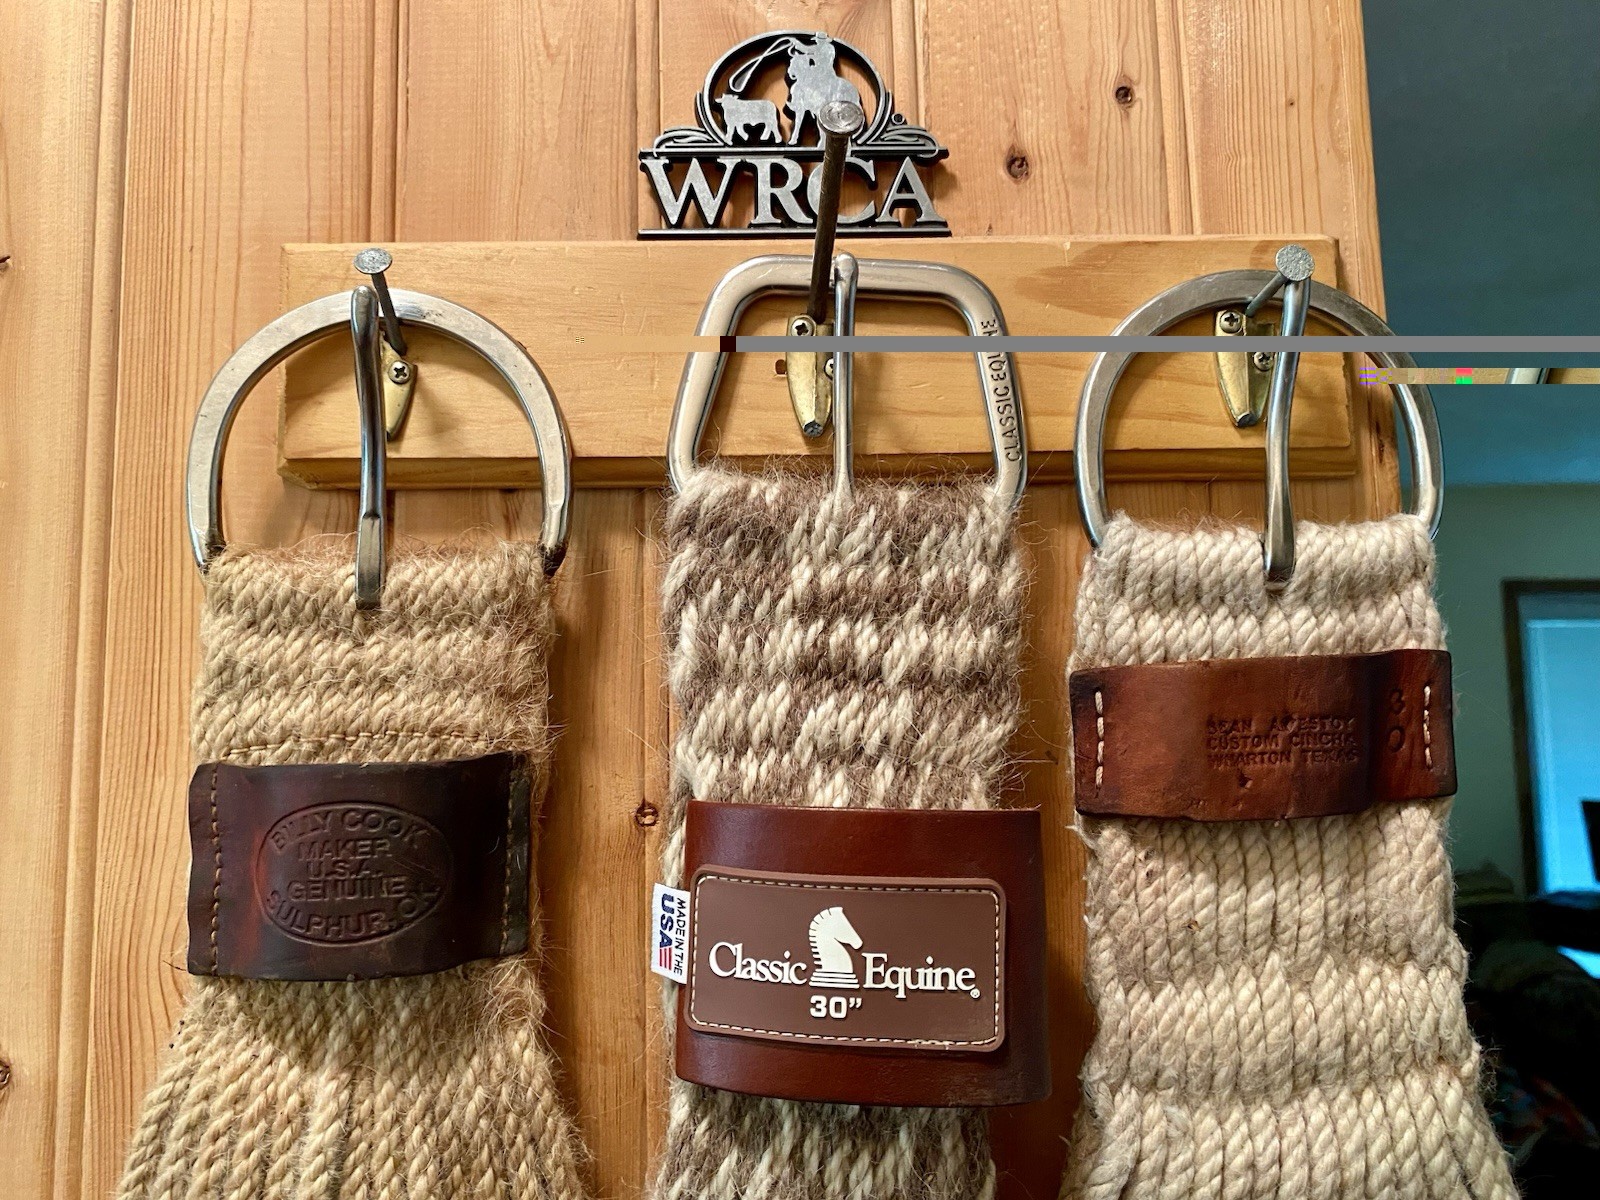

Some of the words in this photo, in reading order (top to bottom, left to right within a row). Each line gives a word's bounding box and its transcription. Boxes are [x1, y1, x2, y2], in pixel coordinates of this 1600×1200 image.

[640, 155, 948, 227] WRCA
[993, 385, 1023, 463] CLASSIC
[1206, 733, 1282, 750] CUSTOM
[1206, 750, 1293, 767] WHARTON
[1301, 749, 1359, 764] TEXAS
[269, 811, 333, 852] BILLY
[341, 808, 431, 847] COOK
[297, 838, 393, 861] MAKER
[286, 876, 409, 901] GENUINE
[659, 893, 675, 949] USA
[675, 897, 687, 937] MADE
[674, 936, 685, 951] IN
[673, 952, 684, 976] THE
[708, 941, 808, 985] Classic
